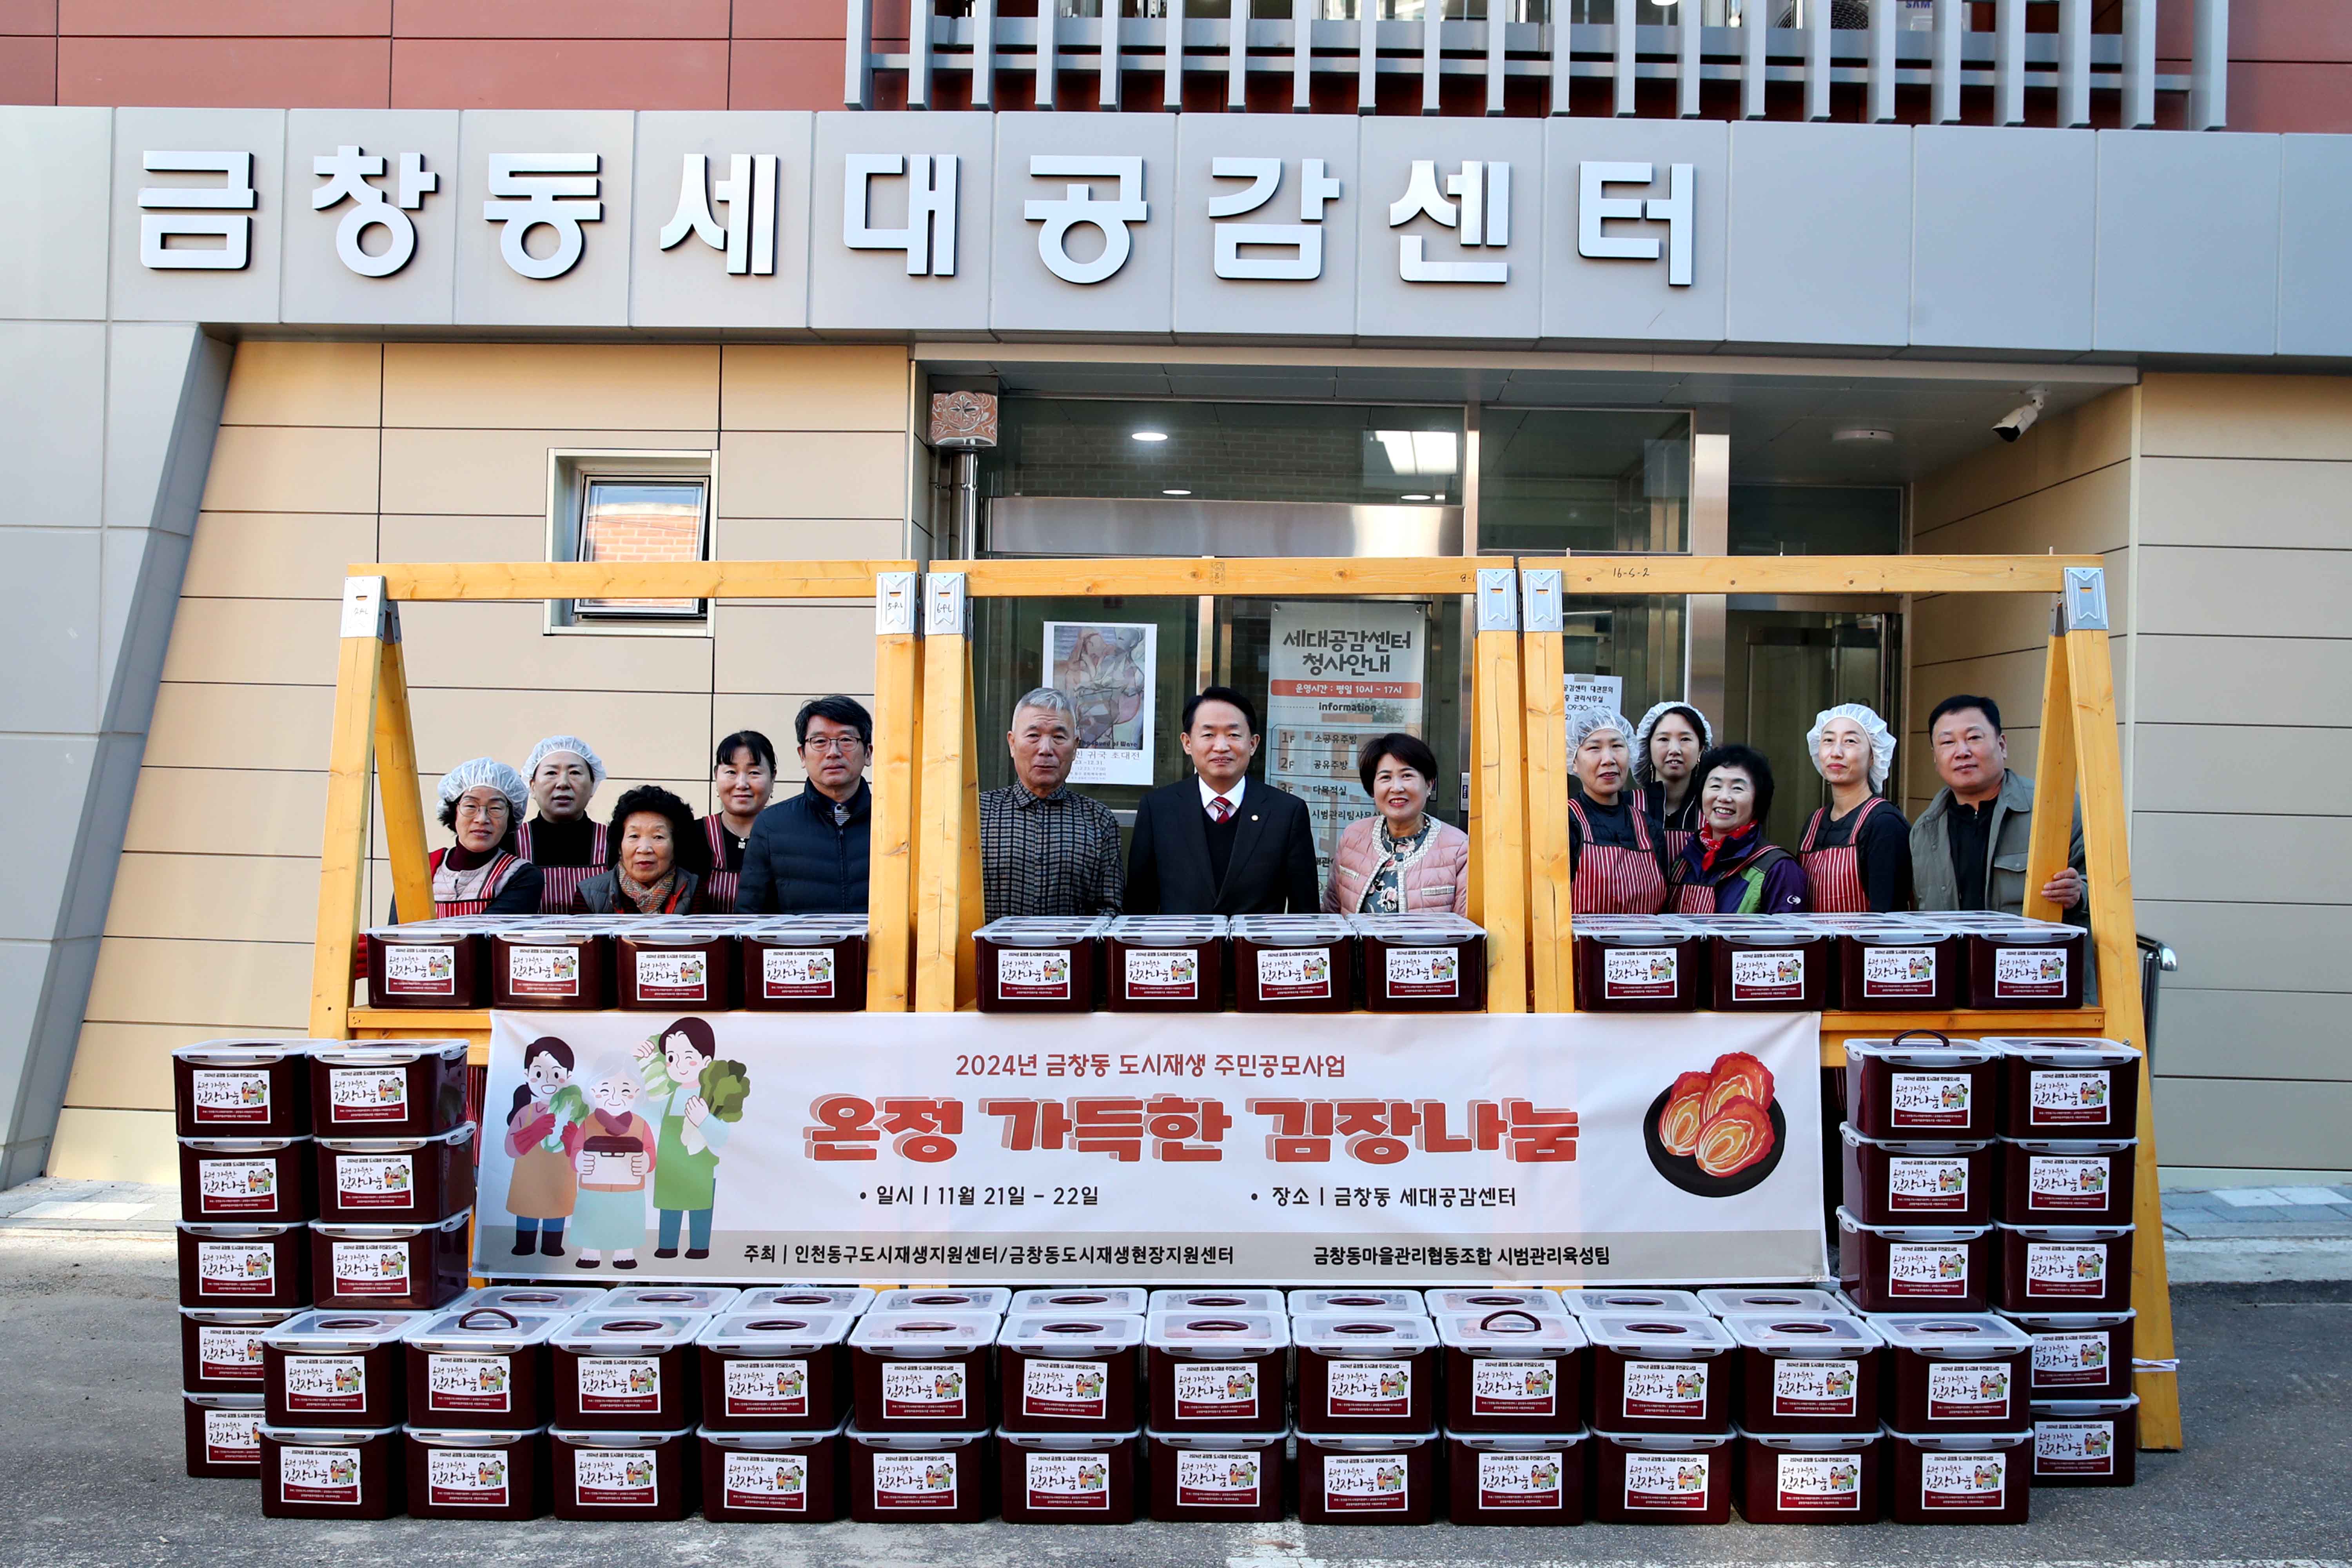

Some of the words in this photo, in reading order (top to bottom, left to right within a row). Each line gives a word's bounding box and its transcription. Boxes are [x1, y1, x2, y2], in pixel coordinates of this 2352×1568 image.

[1283, 630, 1411, 653] 세대공감센터
[1303, 653, 1390, 676] 청사안내
[1296, 684, 1327, 693] 운영시간
[1336, 685, 1352, 694] 평일
[1355, 685, 1372, 694] 10시
[1384, 686, 1402, 694] 17시
[1319, 702, 1376, 712] information
[1281, 732, 1295, 744] 1F
[1314, 734, 1357, 744] 소공유주방
[1280, 758, 1294, 769] 2F
[1314, 760, 1348, 769] 공유주방
[1313, 786, 1347, 795] 다목적실
[388, 965, 426, 978] 김장나눔
[512, 965, 551, 979] 김장나눔
[639, 970, 678, 984] 김장나눔
[766, 967, 806, 982] 김장나눔
[1001, 968, 1041, 983] 김장나눔
[1129, 968, 1169, 982] 김장나눔
[1261, 969, 1301, 984] 김장나눔
[1390, 967, 1429, 982] 김장나눔
[1608, 967, 1648, 982] 김장나눔
[1735, 970, 1775, 984] 김장나눔
[1867, 967, 1907, 981] 김장나눔
[1998, 967, 2038, 981] 김장나눔
[957, 1055, 1036, 1076] 2024년
[1047, 1054, 1110, 1077] 금창동
[1121, 1054, 1205, 1077] 도시재생
[1216, 1055, 1344, 1078] 주민공모사업
[197, 1091, 239, 1105] 김장나눔
[334, 1089, 376, 1105] 김장나눔
[1895, 1094, 1939, 1109] 김장나눔
[2034, 1091, 2078, 1107] 김장나눔
[804, 1093, 964, 1163] 온정
[979, 1093, 1232, 1162] 가득한
[1245, 1098, 1580, 1164] 김장나눔
[204, 1180, 246, 1195] 김장나눔
[340, 1176, 382, 1191] 김장나눔
[1893, 1178, 1936, 1193] 김장나눔
[2032, 1176, 2077, 1192] 김장나눔
[877, 1186, 913, 1205] 일시
[939, 1186, 975, 1205] 11월
[984, 1186, 1024, 1205] 21일
[1053, 1187, 1097, 1205] 22일
[1273, 1187, 1309, 1207] 장소
[1334, 1187, 1390, 1207] 금창동
[1400, 1187, 1515, 1208] 세대공감센터
[744, 1245, 775, 1263] 주최
[1313, 1247, 1492, 1266] 금창동마을관리협동조합
[1497, 1246, 1609, 1266] 시범관리육성팀
[202, 1262, 244, 1278] 김장나눔
[336, 1262, 378, 1278] 김장나눔
[1892, 1263, 1936, 1279] 김장나눔
[2030, 1264, 2074, 1279] 김장나눔
[203, 1348, 245, 1362] 김장나눔
[2035, 1353, 2078, 1369] 김장나눔
[289, 1377, 333, 1393] 김장나눔
[433, 1376, 477, 1392] 김장나눔
[582, 1378, 627, 1394] 김장나눔
[728, 1382, 774, 1398] 김장나눔
[886, 1384, 932, 1400] 김장나눔
[1027, 1381, 1073, 1397] 김장나눔
[1331, 1382, 1377, 1398] 김장나눔
[1476, 1381, 1523, 1397] 김장나눔
[1627, 1383, 1673, 1399] 김장나눔
[1777, 1381, 1823, 1397] 김장나눔
[1178, 1385, 1224, 1401] 김장나눔
[1931, 1385, 1978, 1401] 김장나눔
[209, 1431, 250, 1445] 김장나눔
[2038, 1442, 2082, 1457] 김장나눔
[284, 1468, 328, 1484] 김장나눔
[432, 1471, 476, 1486] 김장나눔
[579, 1471, 624, 1487] 김장나눔
[728, 1474, 773, 1491] 김장나눔
[878, 1475, 923, 1491] 김장나눔
[1030, 1475, 1076, 1490] 김장나눔
[1181, 1472, 1227, 1487] 김장나눔
[1482, 1474, 1528, 1490] 김장나눔
[1628, 1474, 1675, 1490] 김장나눔
[1781, 1475, 1827, 1492] 김장나눔
[1925, 1475, 1971, 1491] 김장나눔
[1328, 1477, 1374, 1493] 김장나눔
